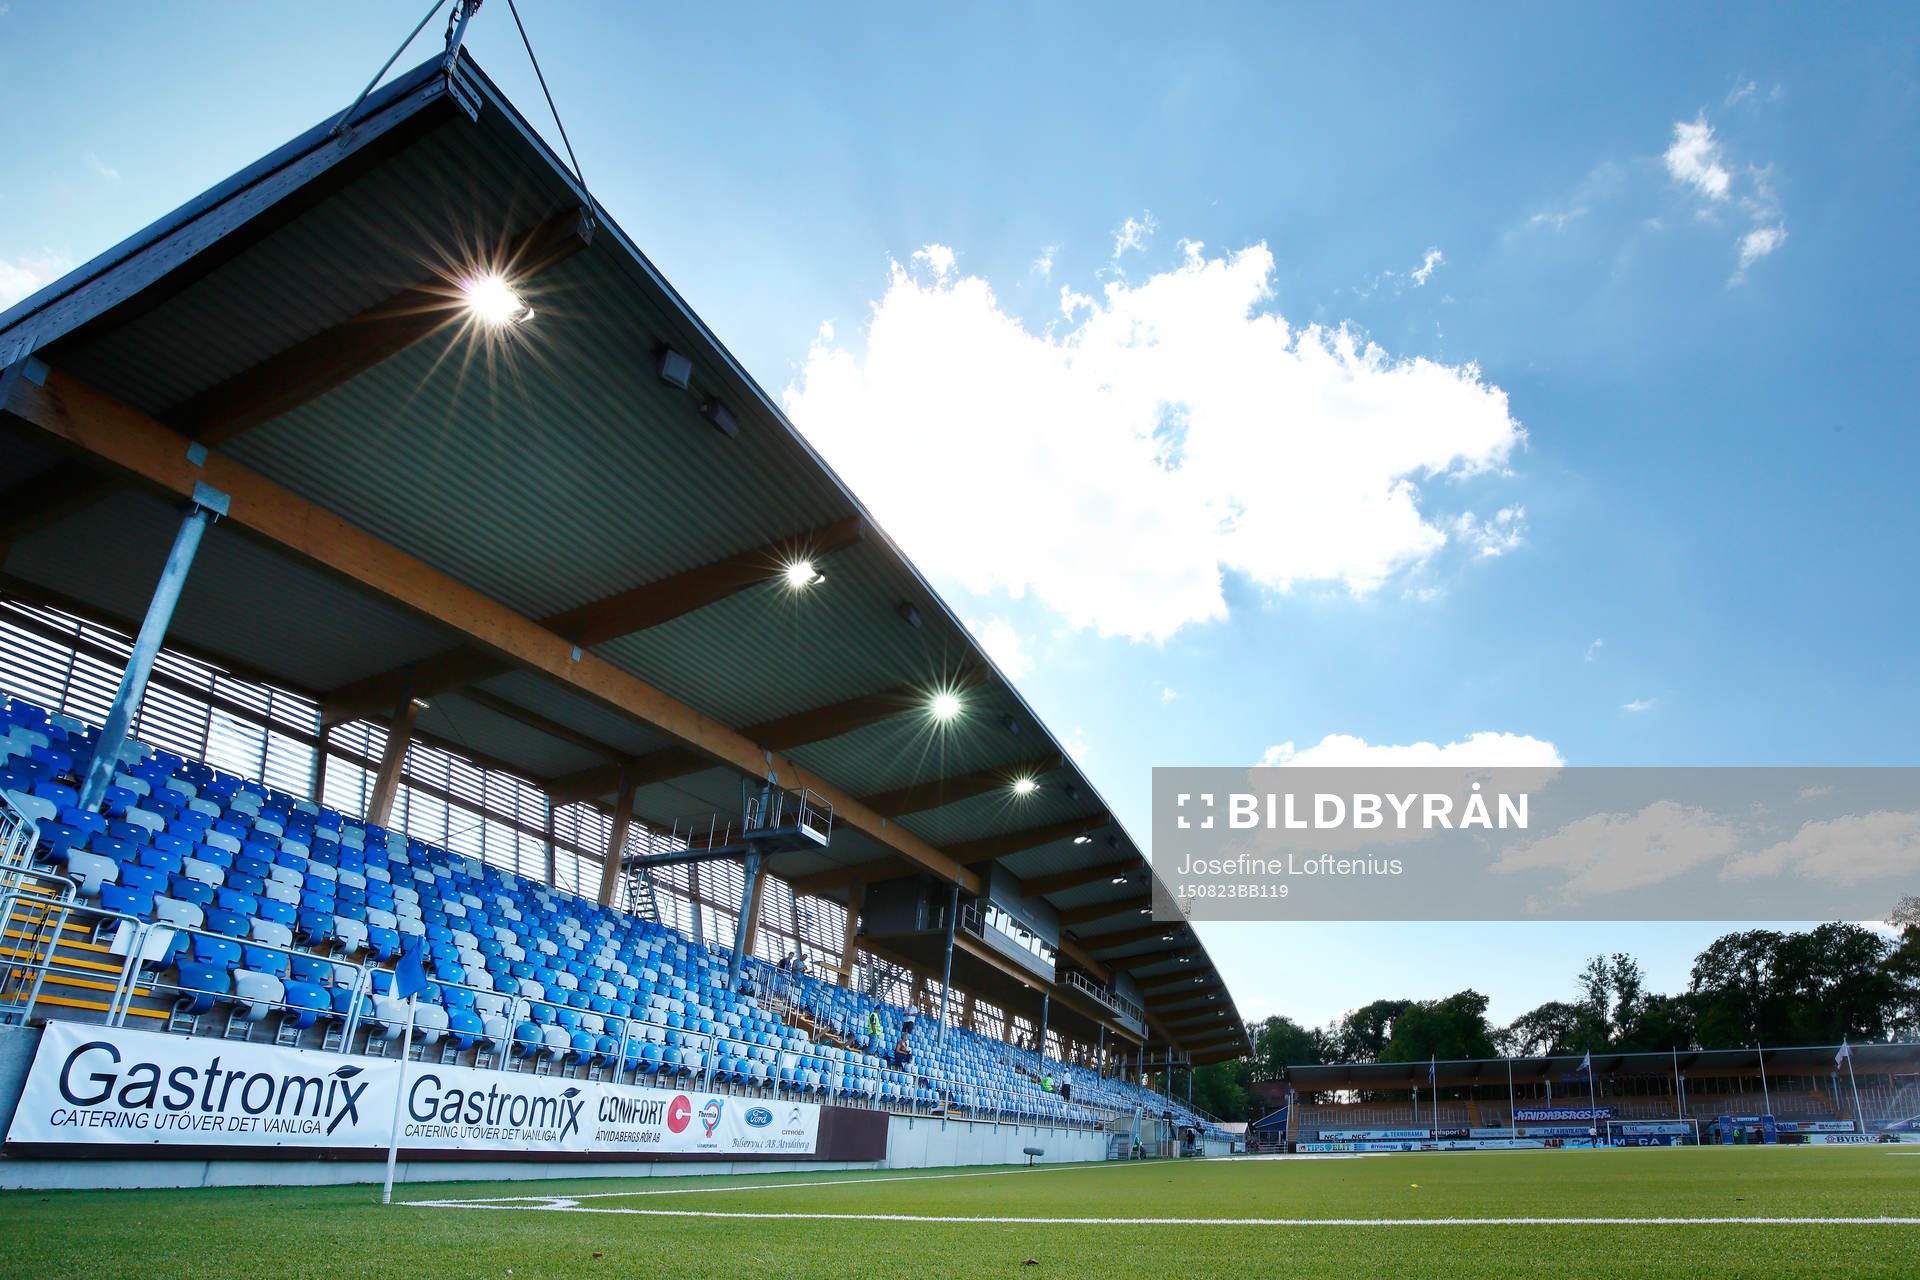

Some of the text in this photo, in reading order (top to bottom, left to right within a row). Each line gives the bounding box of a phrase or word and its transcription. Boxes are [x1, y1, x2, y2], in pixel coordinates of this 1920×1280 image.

[58, 1041, 371, 1136] Gastromix
[408, 1073, 587, 1142] Gastromix
[598, 1096, 667, 1126] COMFORT
[749, 1110, 769, 1125] Ford
[50, 1109, 321, 1134] CATERING UTÖVER DET VANLIGA
[404, 1123, 557, 1141] CATERING UTÖVER DET VANLIGA
[652, 1132, 661, 1143] AB
